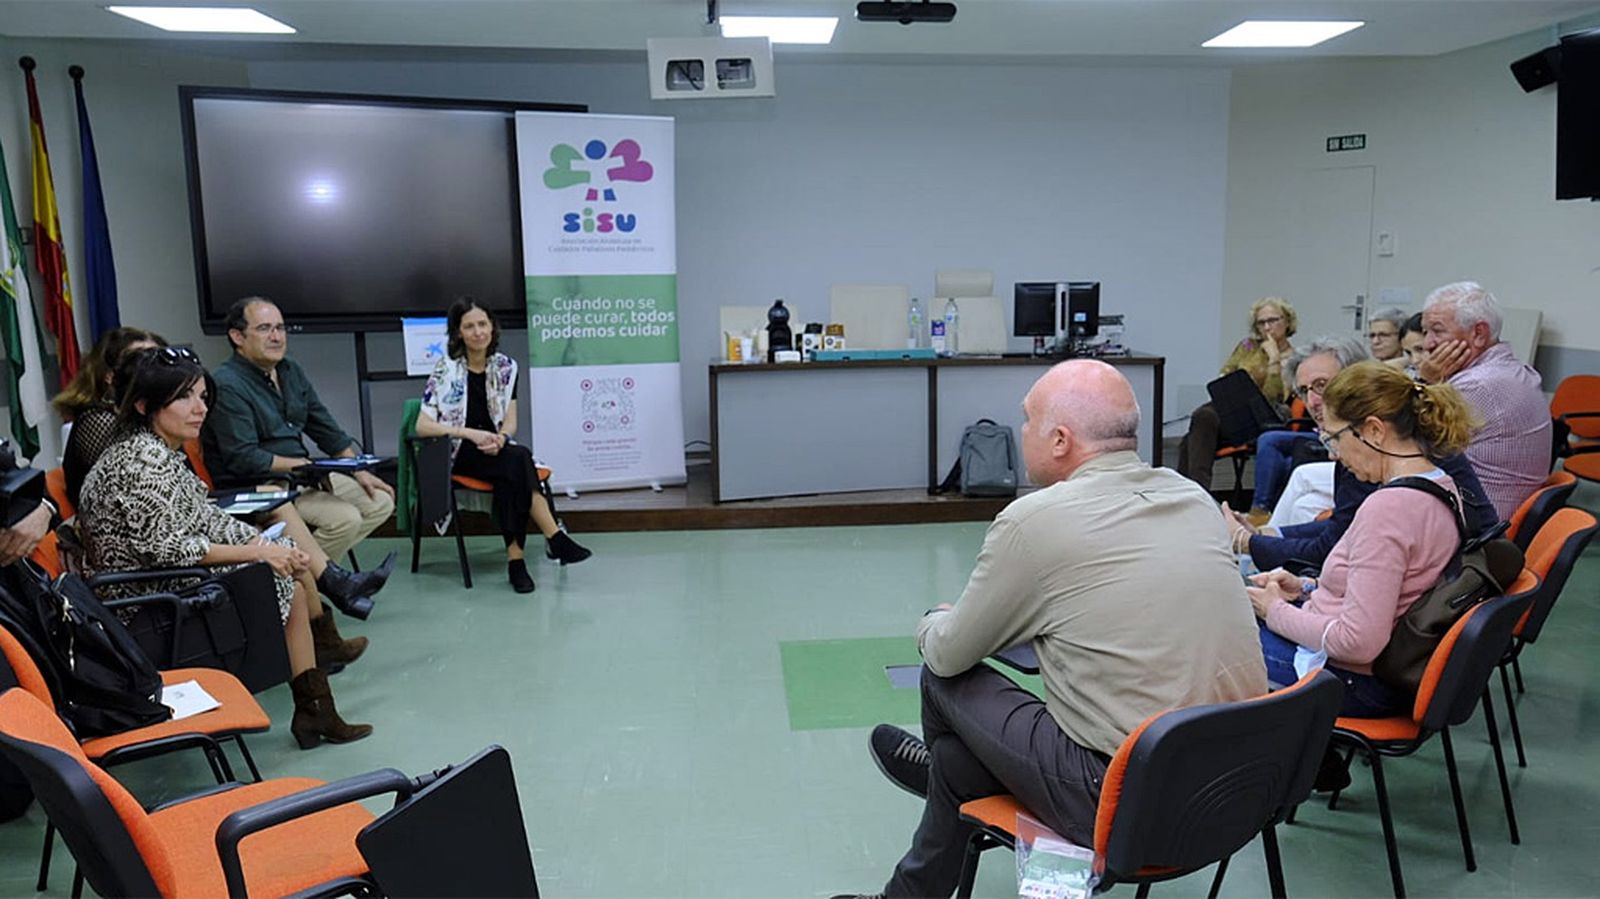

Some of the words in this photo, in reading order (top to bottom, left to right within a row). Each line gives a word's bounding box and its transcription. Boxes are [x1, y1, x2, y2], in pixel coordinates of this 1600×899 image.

[1341, 136, 1363, 149] SALIDA
[552, 296, 612, 311] Cuando
[615, 299, 635, 310] no
[638, 298, 656, 309] se
[532, 311, 581, 328] puede
[584, 312, 628, 324] curar,
[631, 310, 676, 323] todos
[541, 324, 616, 343] podemos
[618, 323, 669, 337] cuidar
